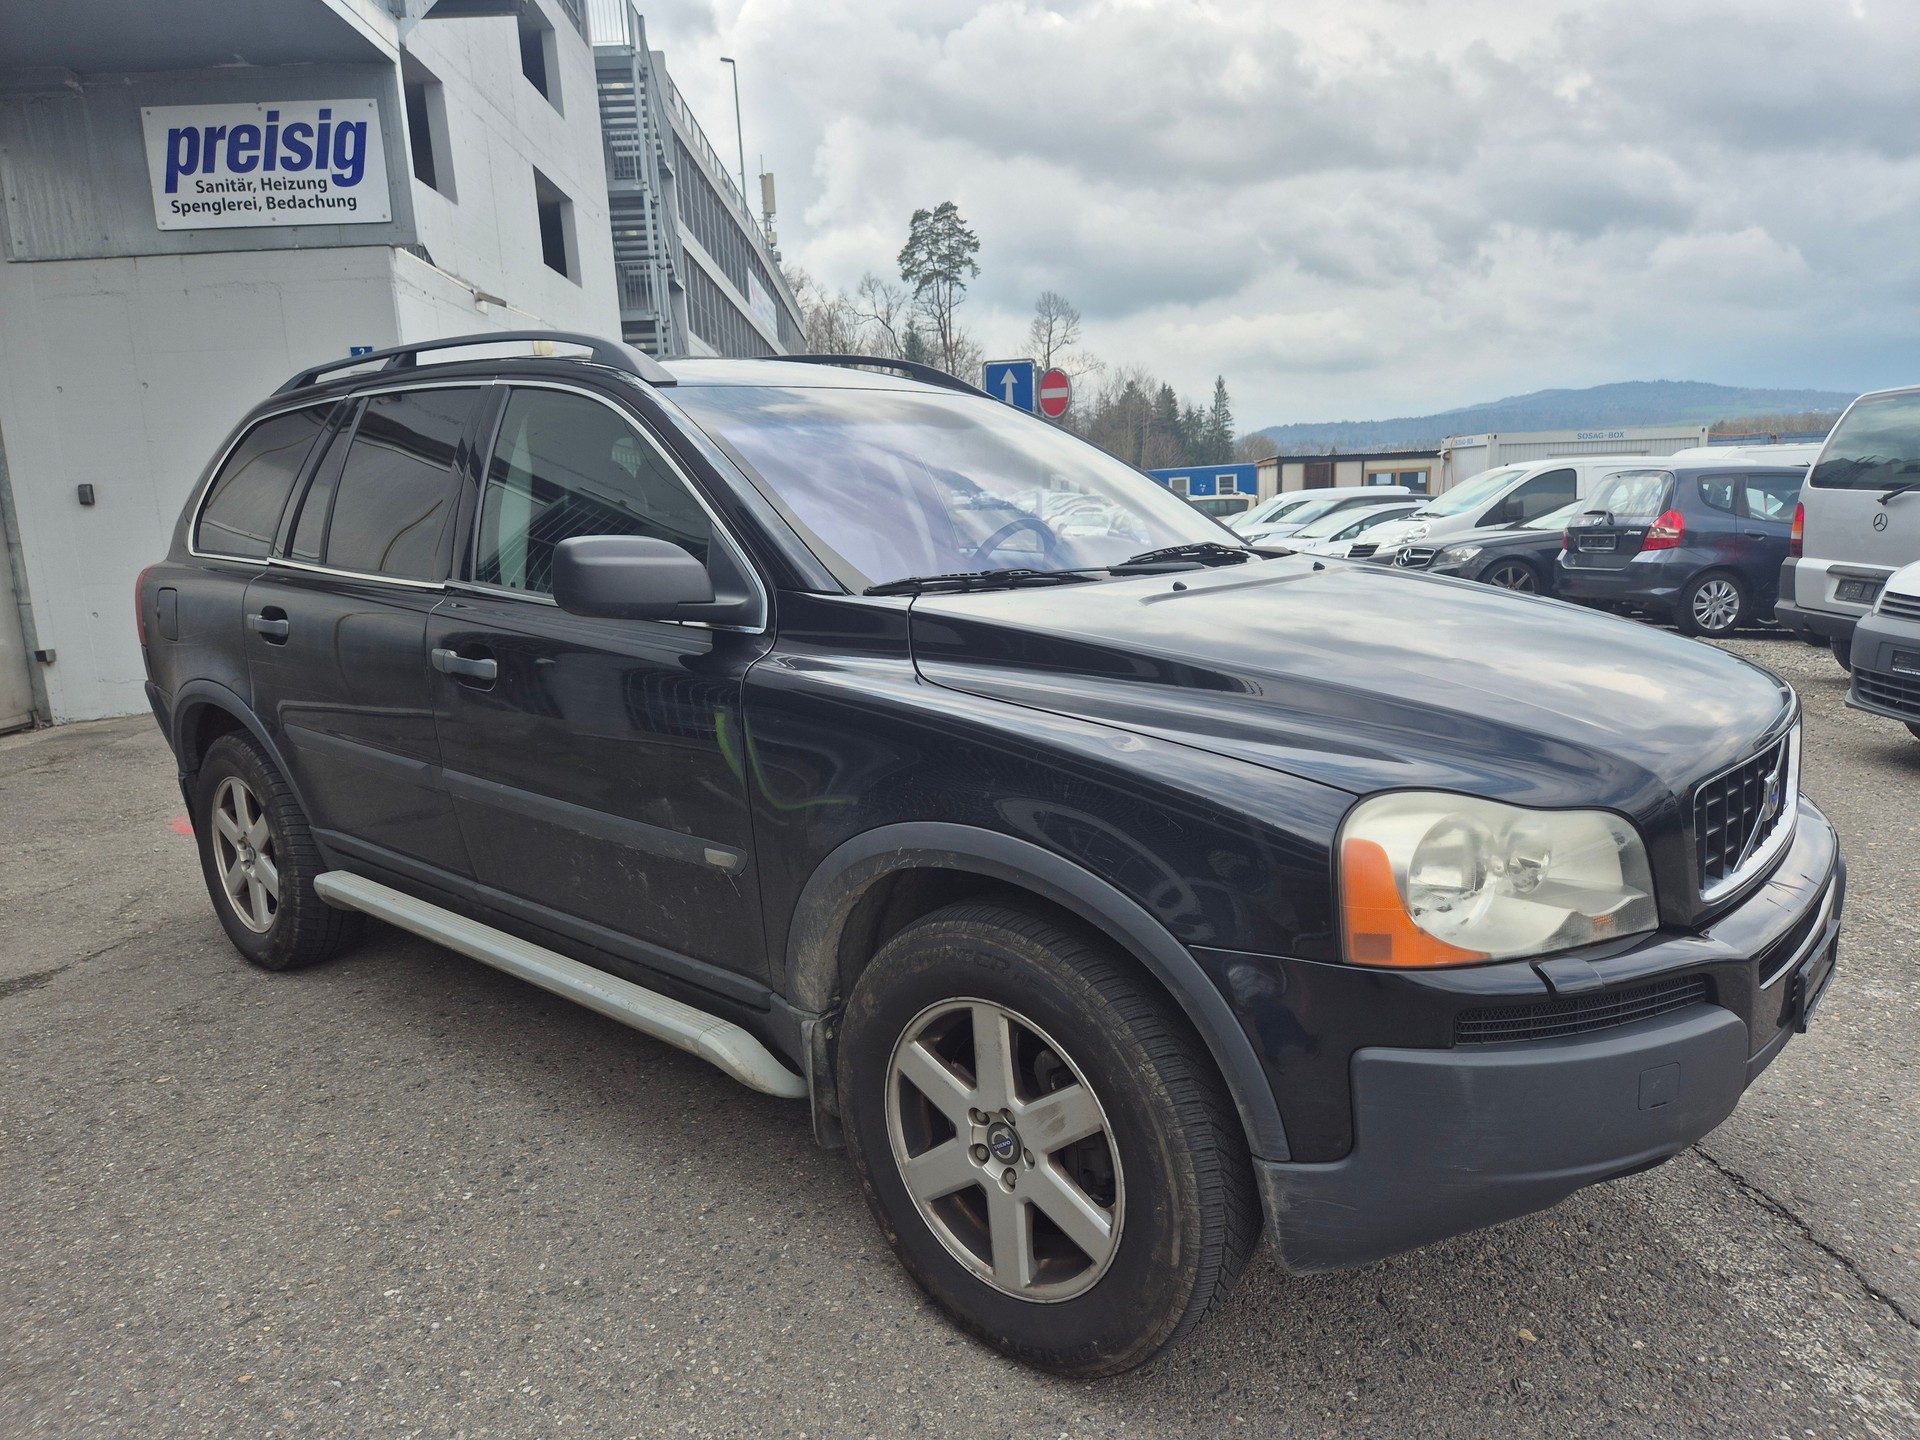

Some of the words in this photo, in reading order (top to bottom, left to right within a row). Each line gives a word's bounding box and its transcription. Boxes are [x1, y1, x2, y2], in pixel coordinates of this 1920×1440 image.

[164, 108, 368, 193] preisig
[195, 178, 256, 194] Sanitär,
[260, 176, 328, 192] Heizung
[171, 197, 262, 216] Spenglerei,
[265, 194, 357, 211] Bedachung
[993, 1140, 1011, 1150] VOLVO
